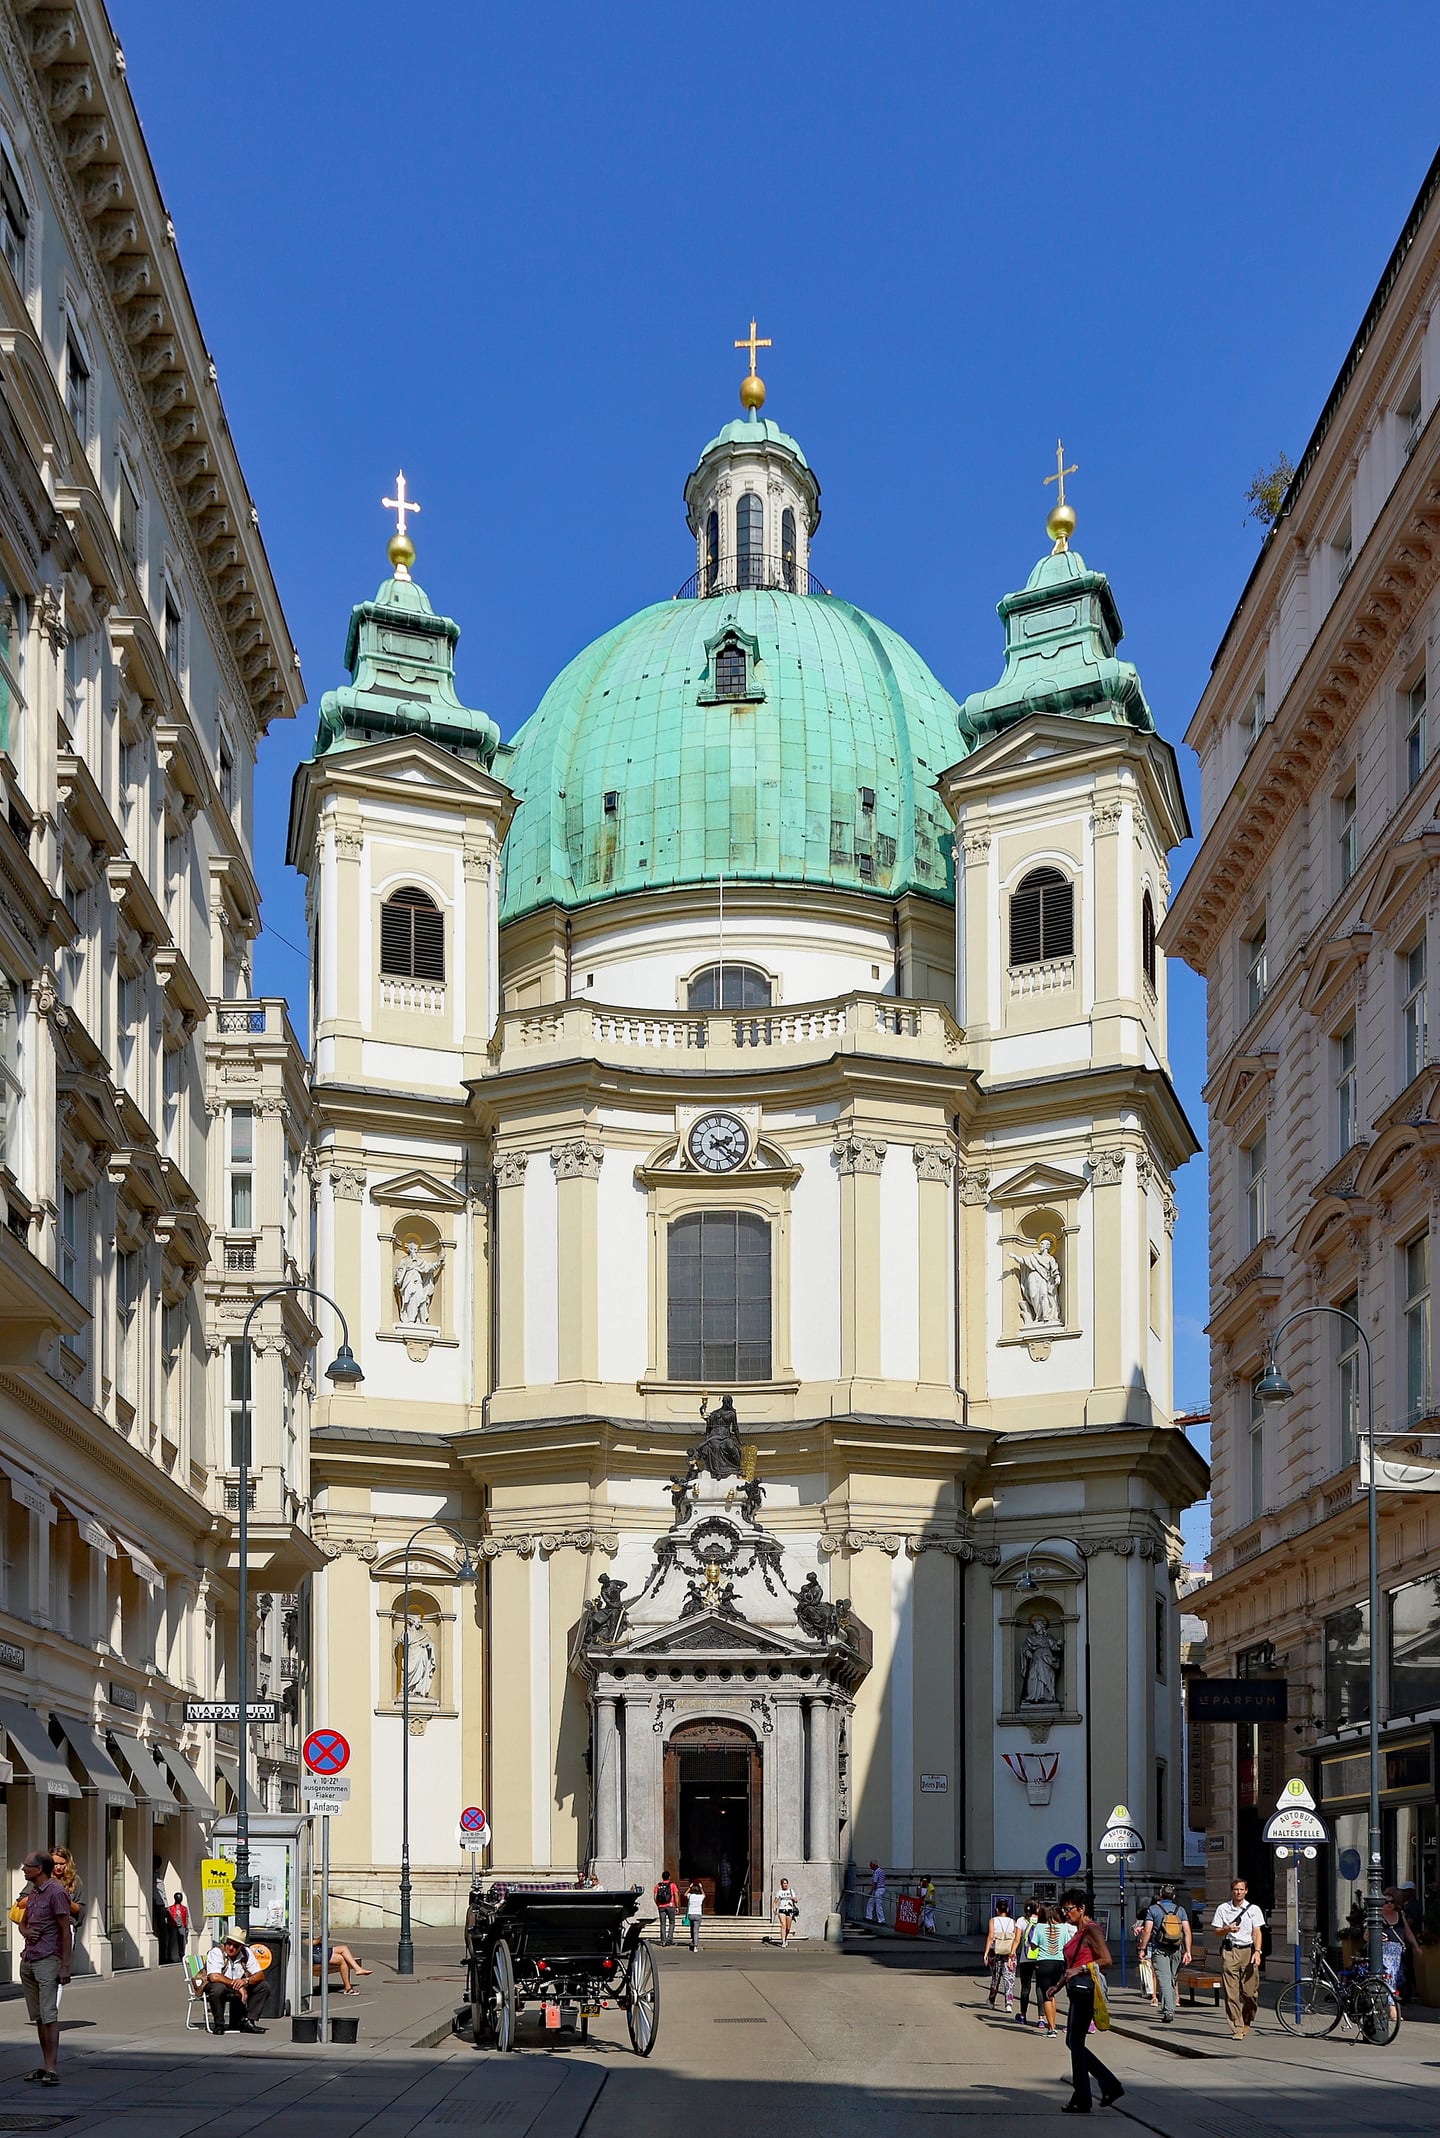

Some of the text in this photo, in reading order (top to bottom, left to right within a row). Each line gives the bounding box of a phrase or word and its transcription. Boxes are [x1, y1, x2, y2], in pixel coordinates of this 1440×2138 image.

[1213, 1696, 1276, 1705] PARFUM
[313, 1802, 340, 1814] Anfang
[1280, 1812, 1315, 1824] AUTOBUS
[1108, 1829, 1134, 1839] AUTOBUS
[1272, 1830, 1321, 1838] HALTESTELLE
[584, 2005, 598, 2013] F59
